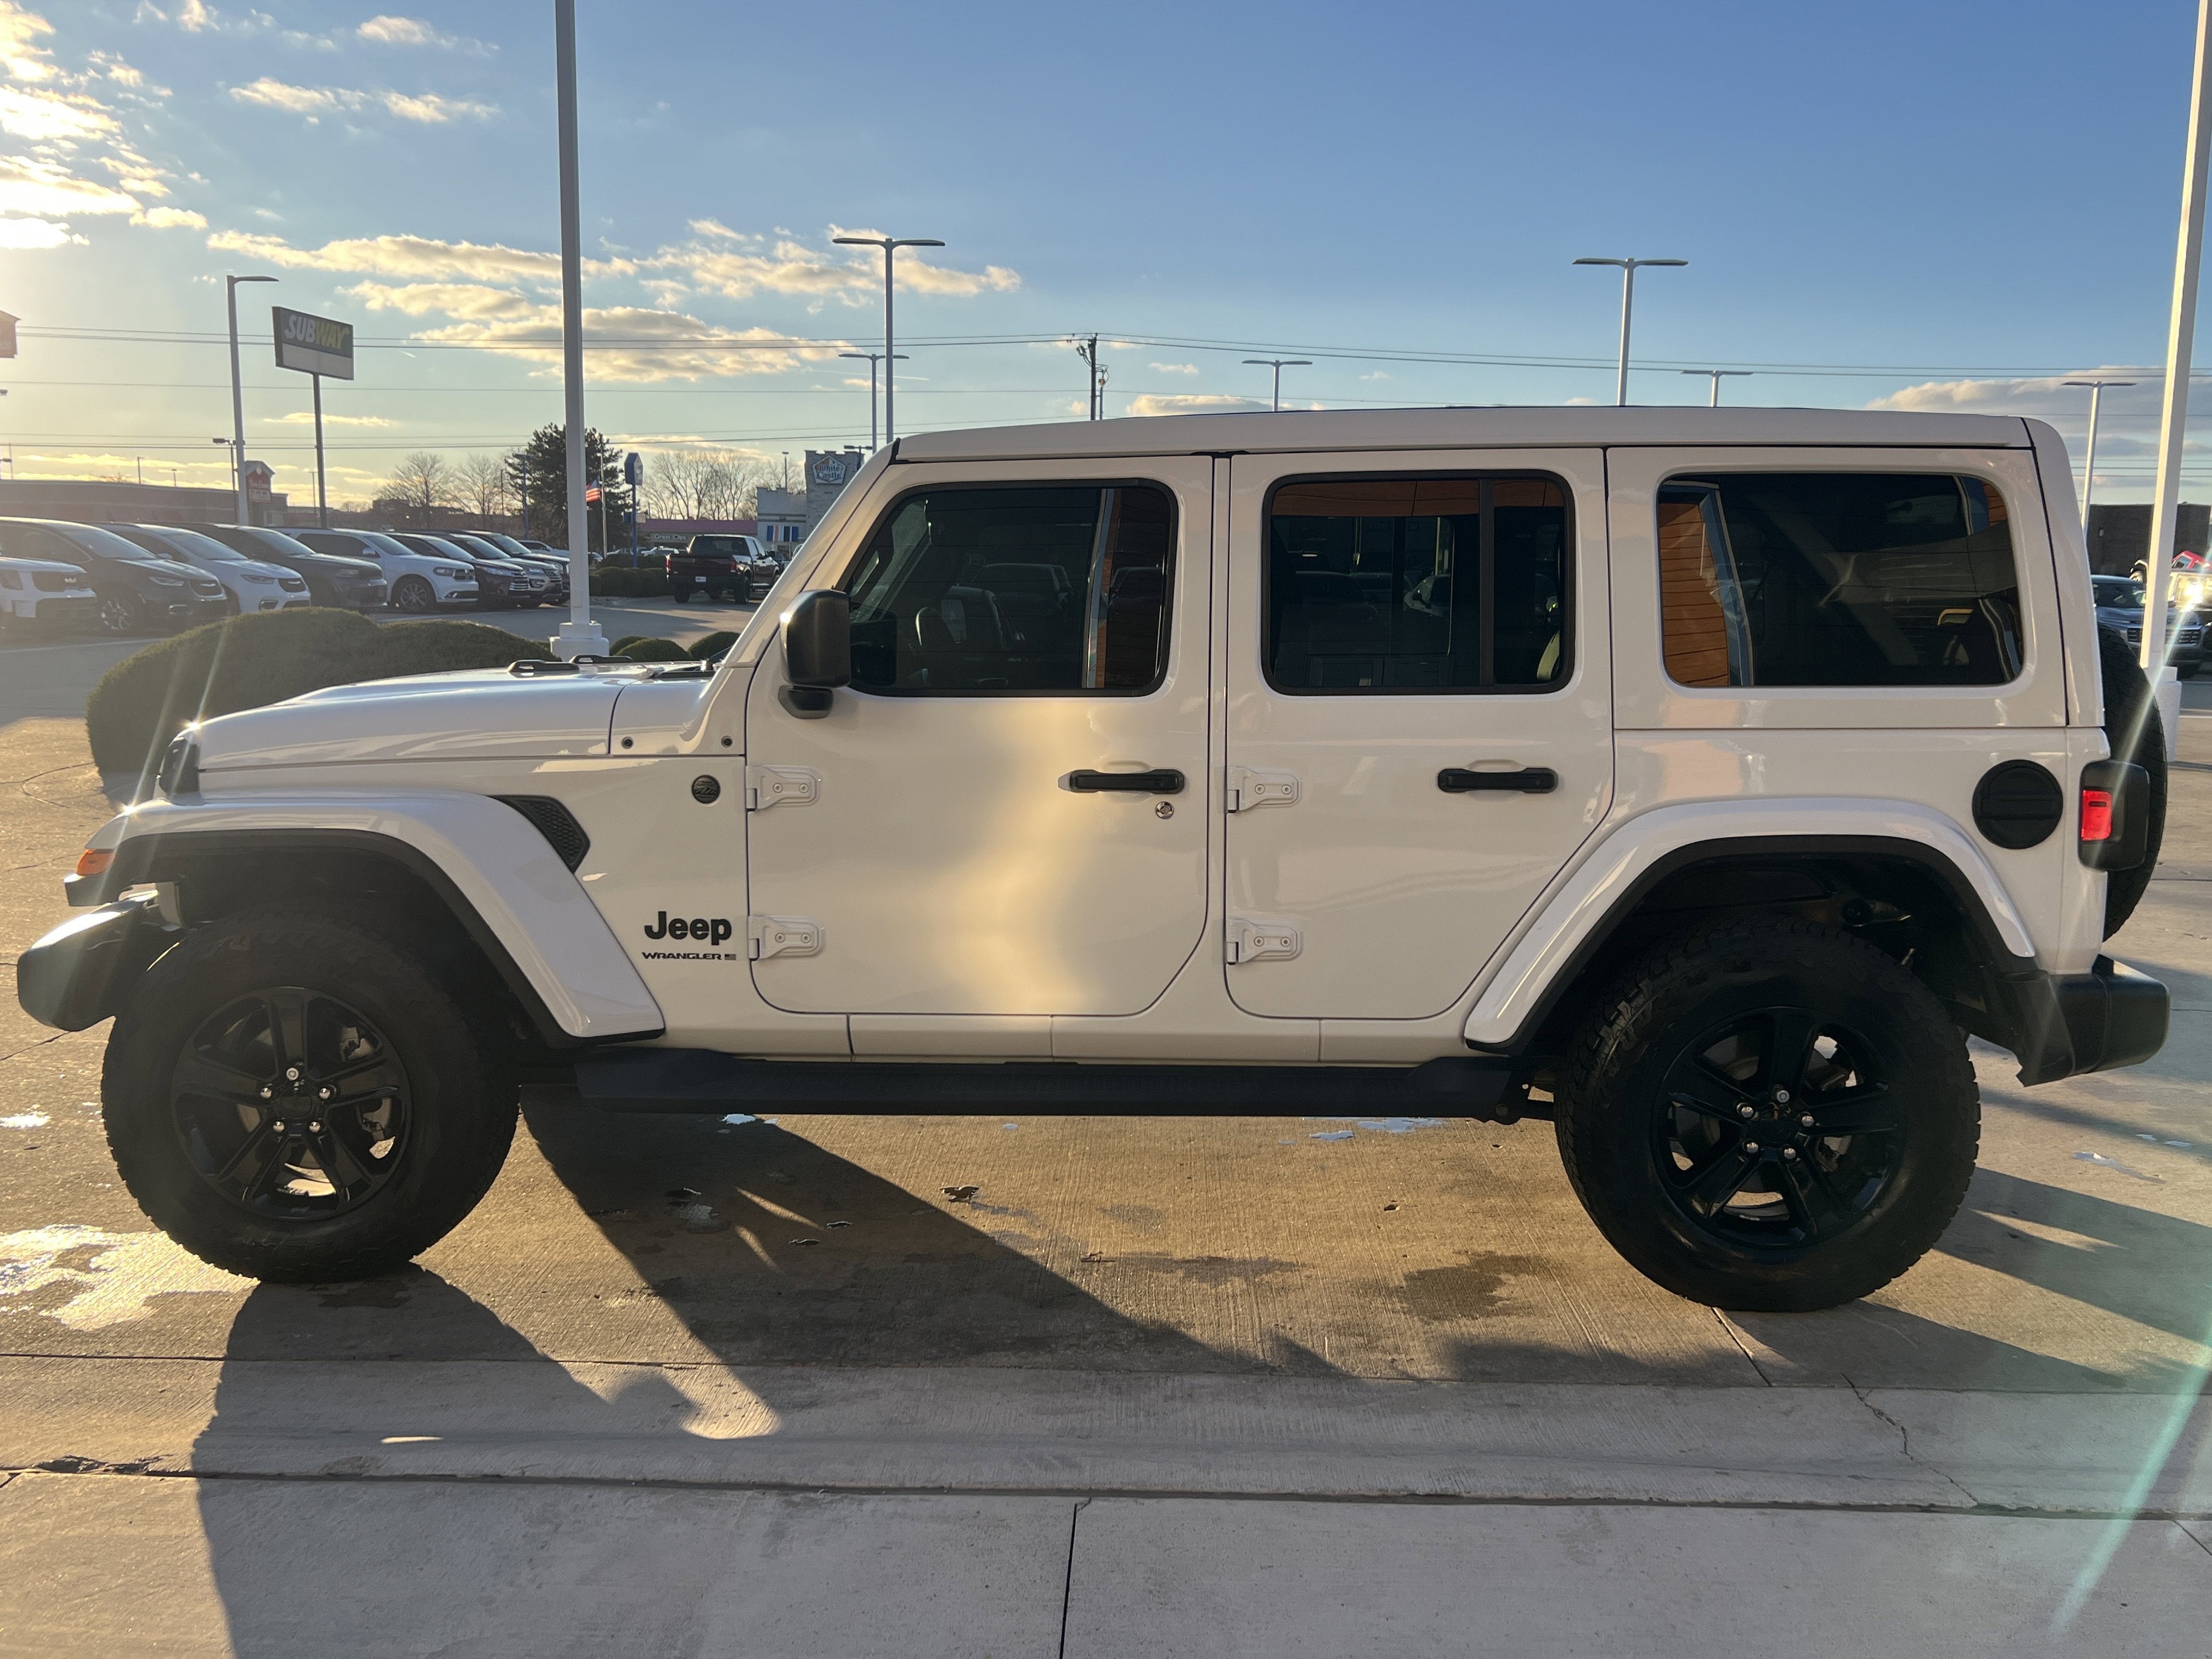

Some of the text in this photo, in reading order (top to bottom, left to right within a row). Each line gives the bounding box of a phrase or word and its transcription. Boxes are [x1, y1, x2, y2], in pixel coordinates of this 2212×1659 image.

[284, 314, 351, 351] SUBWAY
[816, 464, 840, 472] White
[644, 911, 732, 946] Jeep
[641, 952, 723, 960] WRANGLER
